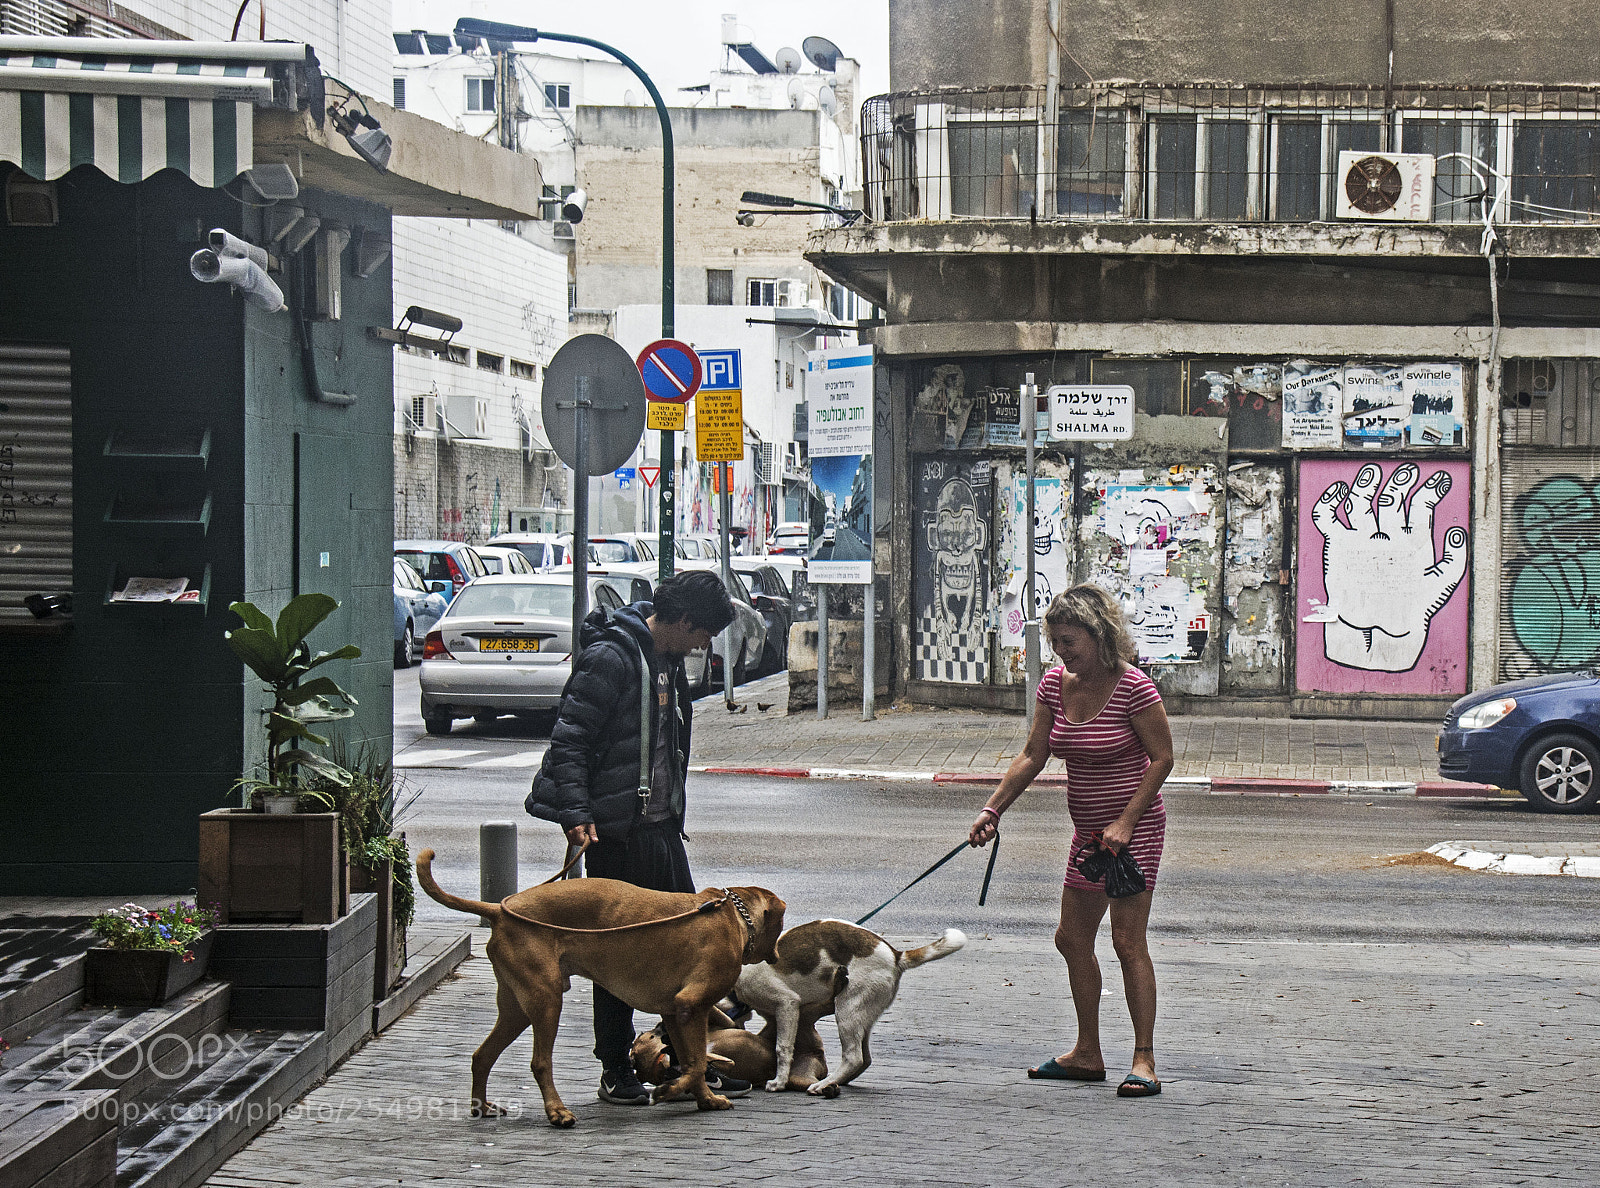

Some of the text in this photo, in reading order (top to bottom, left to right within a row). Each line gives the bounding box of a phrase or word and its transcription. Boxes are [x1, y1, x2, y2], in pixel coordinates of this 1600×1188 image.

[1406, 370, 1451, 379] swingle
[1285, 381, 1300, 390] Our
[1057, 391, 1128, 406] דרך שלמה
[816, 405, 865, 423] רחוב אבולעפיה
[995, 407, 1018, 417] בהופעה
[1056, 423, 1109, 433] SHALMA
